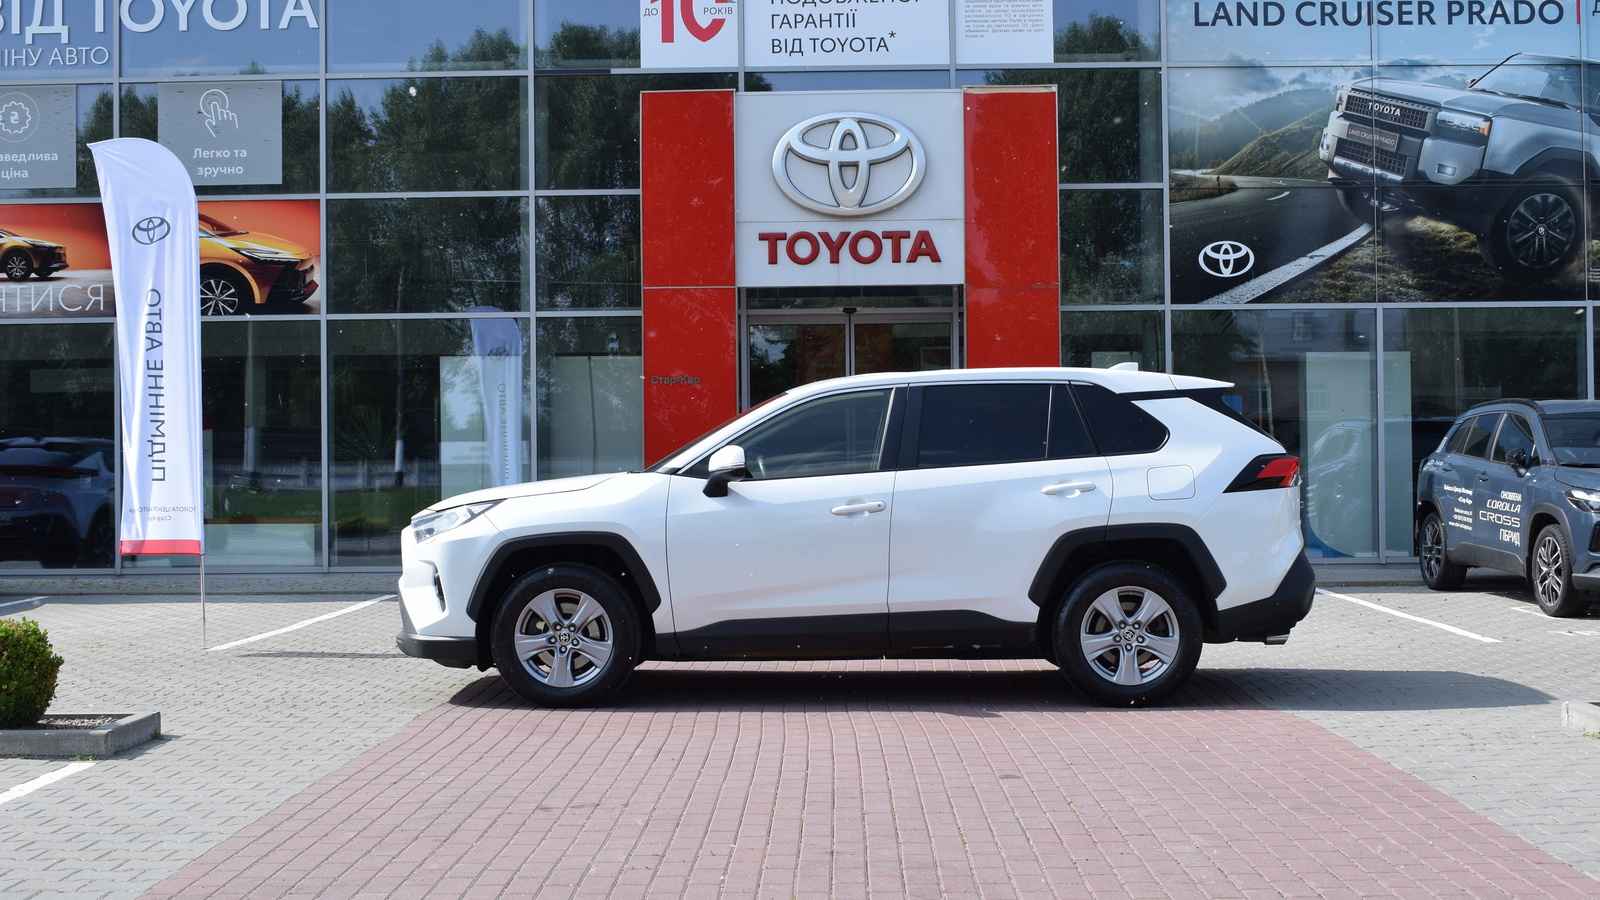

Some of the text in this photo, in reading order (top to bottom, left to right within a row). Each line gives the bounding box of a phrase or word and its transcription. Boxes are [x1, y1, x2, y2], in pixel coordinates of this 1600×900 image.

[643, 8, 658, 17] ДО
[703, 7, 733, 15] РОКІВ
[1194, 1, 1285, 26] LAND
[1295, 0, 1437, 26] CRUISER
[1447, 0, 1564, 25] PRADO
[0, 0, 68, 44] ІД
[771, 9, 858, 29] ГАРАНТІЇ
[771, 38, 804, 57] ВІД
[0, 46, 109, 66] ІНУ АВТО
[1368, 102, 1401, 116] TOYOTA
[1348, 128, 1361, 137] LAND
[193, 148, 247, 158] Легко та
[1, 167, 29, 180] ціна
[197, 166, 244, 178] зручно
[758, 230, 942, 265] TOYOTA
[650, 375, 701, 387] Стар-Кар
[1486, 499, 1521, 514] COROLLA
[1479, 510, 1521, 528] CROSS
